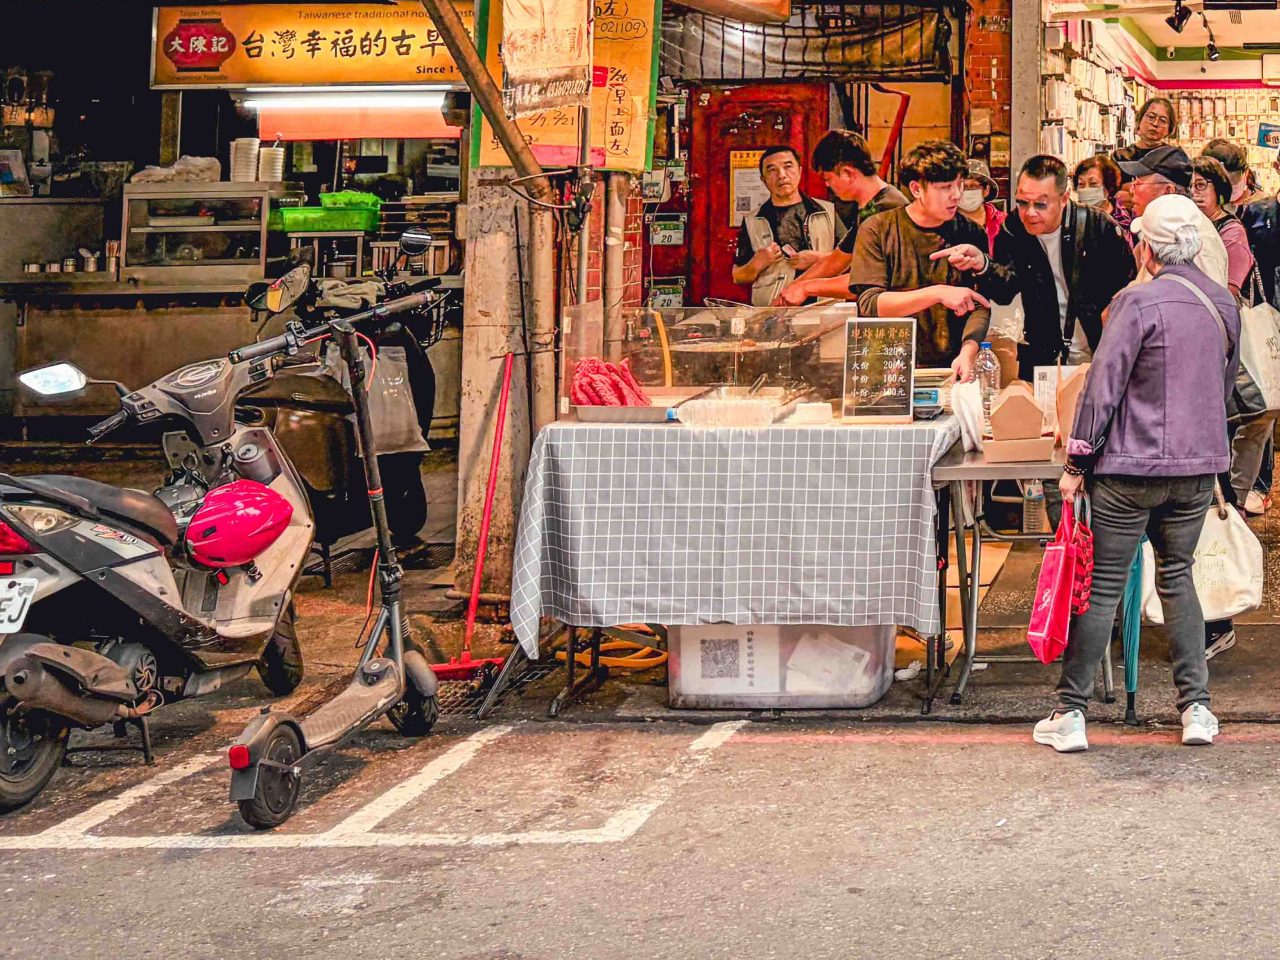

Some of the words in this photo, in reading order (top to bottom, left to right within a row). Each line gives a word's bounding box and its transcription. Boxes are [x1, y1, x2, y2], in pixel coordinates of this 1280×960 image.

[298, 10, 352, 19] Taiwanese
[354, 9, 409, 19] traditional
[168, 36, 229, 53] 大陳記
[242, 28, 474, 59] 台灣幸福的古早
[415, 65, 446, 74] Since
